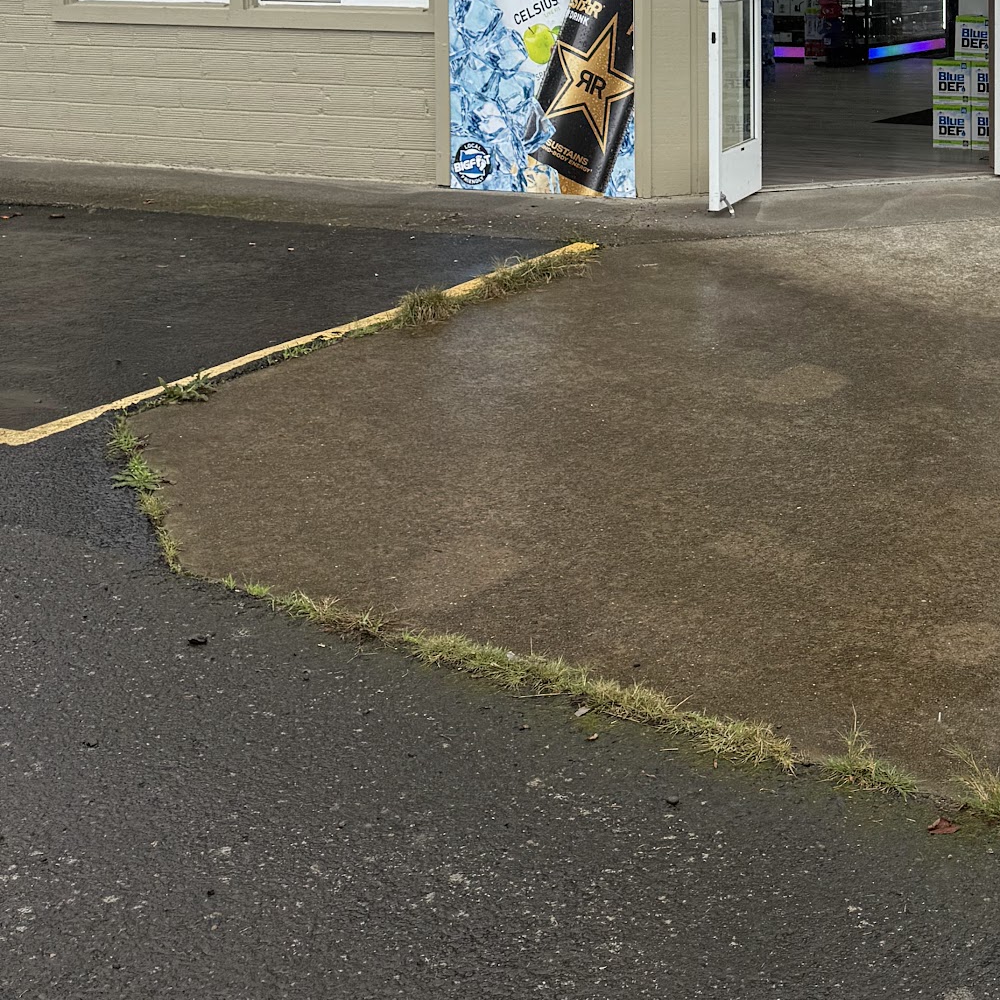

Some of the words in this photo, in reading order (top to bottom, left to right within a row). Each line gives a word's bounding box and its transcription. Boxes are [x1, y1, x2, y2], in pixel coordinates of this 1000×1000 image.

[962, 28, 988, 38] Blue
[962, 39, 986, 49] DEF
[938, 71, 965, 82] Blue
[978, 73, 988, 82] Bl
[938, 82, 964, 92] DEF
[938, 115, 965, 126] Blue
[978, 117, 988, 126] Bl
[938, 126, 964, 137] DEF
[545, 138, 589, 166] SUSTAINS
